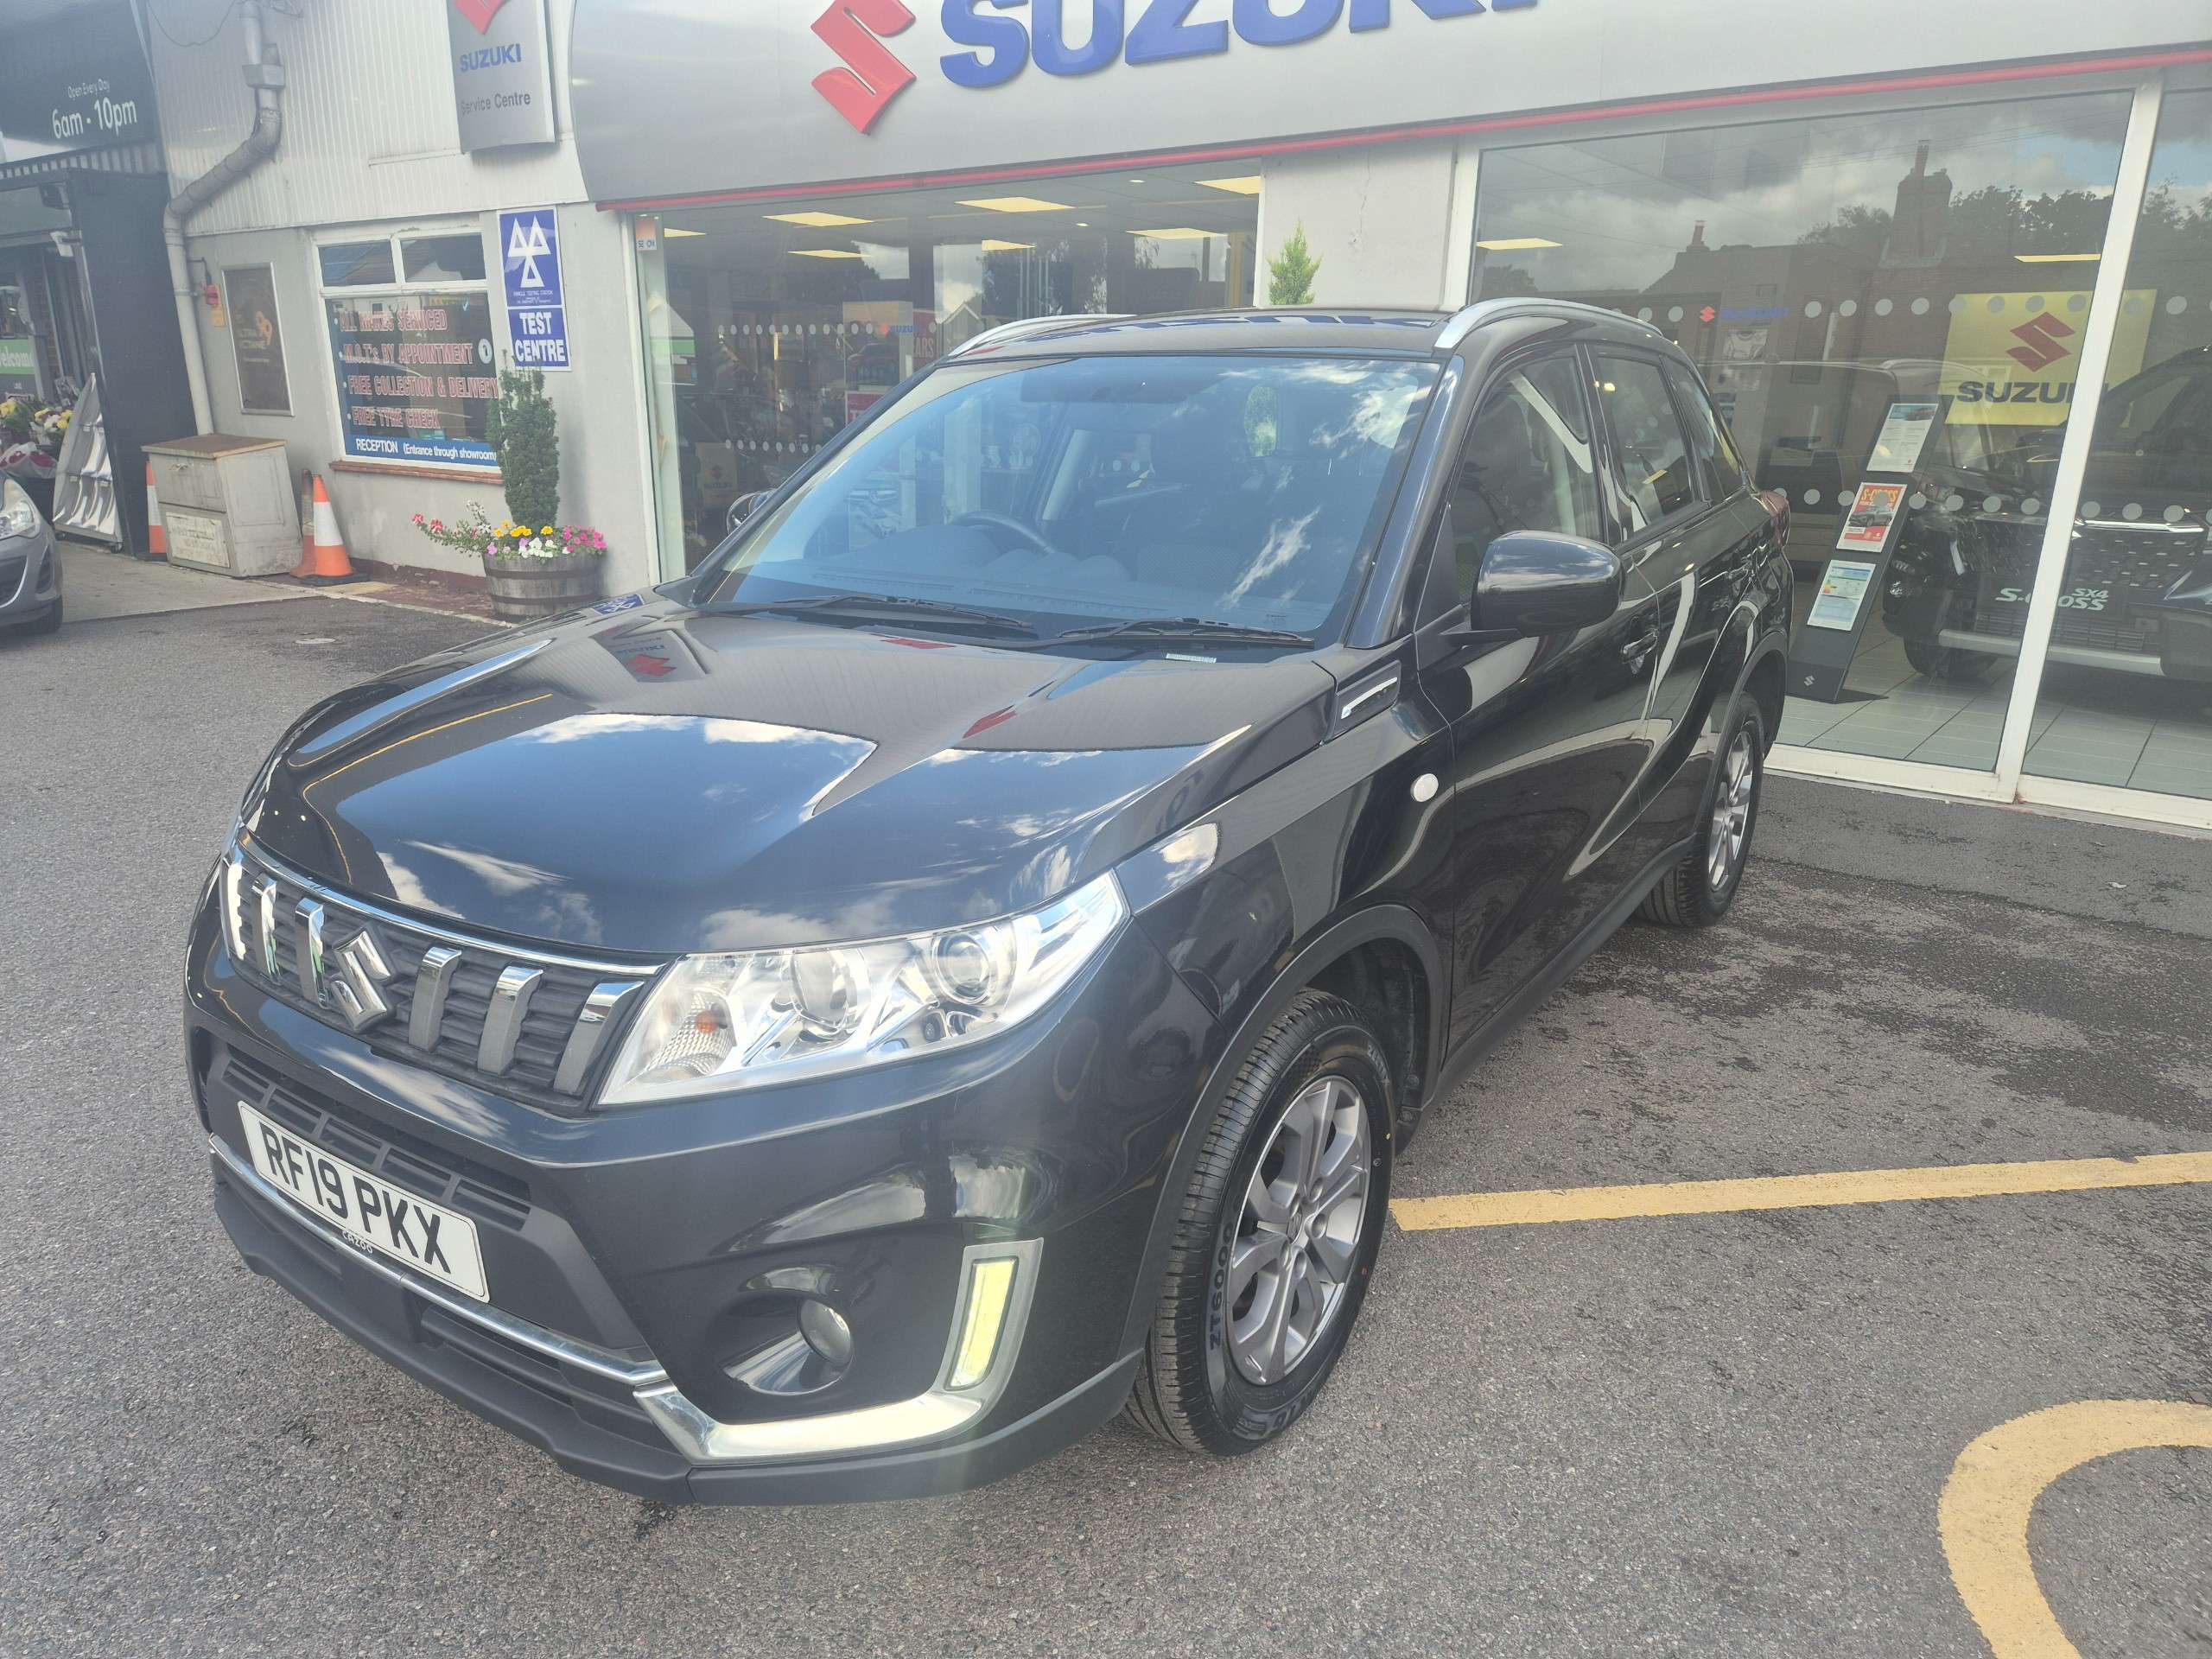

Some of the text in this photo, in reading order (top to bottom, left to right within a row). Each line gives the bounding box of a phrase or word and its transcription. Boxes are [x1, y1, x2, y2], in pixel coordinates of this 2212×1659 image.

[940, 0, 1538, 87] SUZ
[460, 43, 522, 73] SUZUKI
[68, 79, 111, 100] Open Every Day
[461, 92, 531, 115] Service Centre
[52, 109, 84, 139] 6am
[94, 97, 137, 137] 10pm
[340, 311, 359, 332] ALL
[397, 309, 448, 332] SERVICED
[519, 311, 552, 335] TEST
[381, 343, 395, 364] BY
[398, 343, 474, 365] APPOINTMENT
[515, 339, 566, 362] CENTRE
[916, 336, 935, 359] ARS
[347, 375, 499, 399] FREE COLLECTION & DELIVERY
[1956, 381, 2075, 404] SUZU
[352, 406, 442, 429] FREE TYRE CHECK
[355, 438, 497, 462] RECEPTION (Entrance through showroom)
[2071, 588, 2109, 600] SX4
[258, 1120, 451, 1274] RF19 PKX
